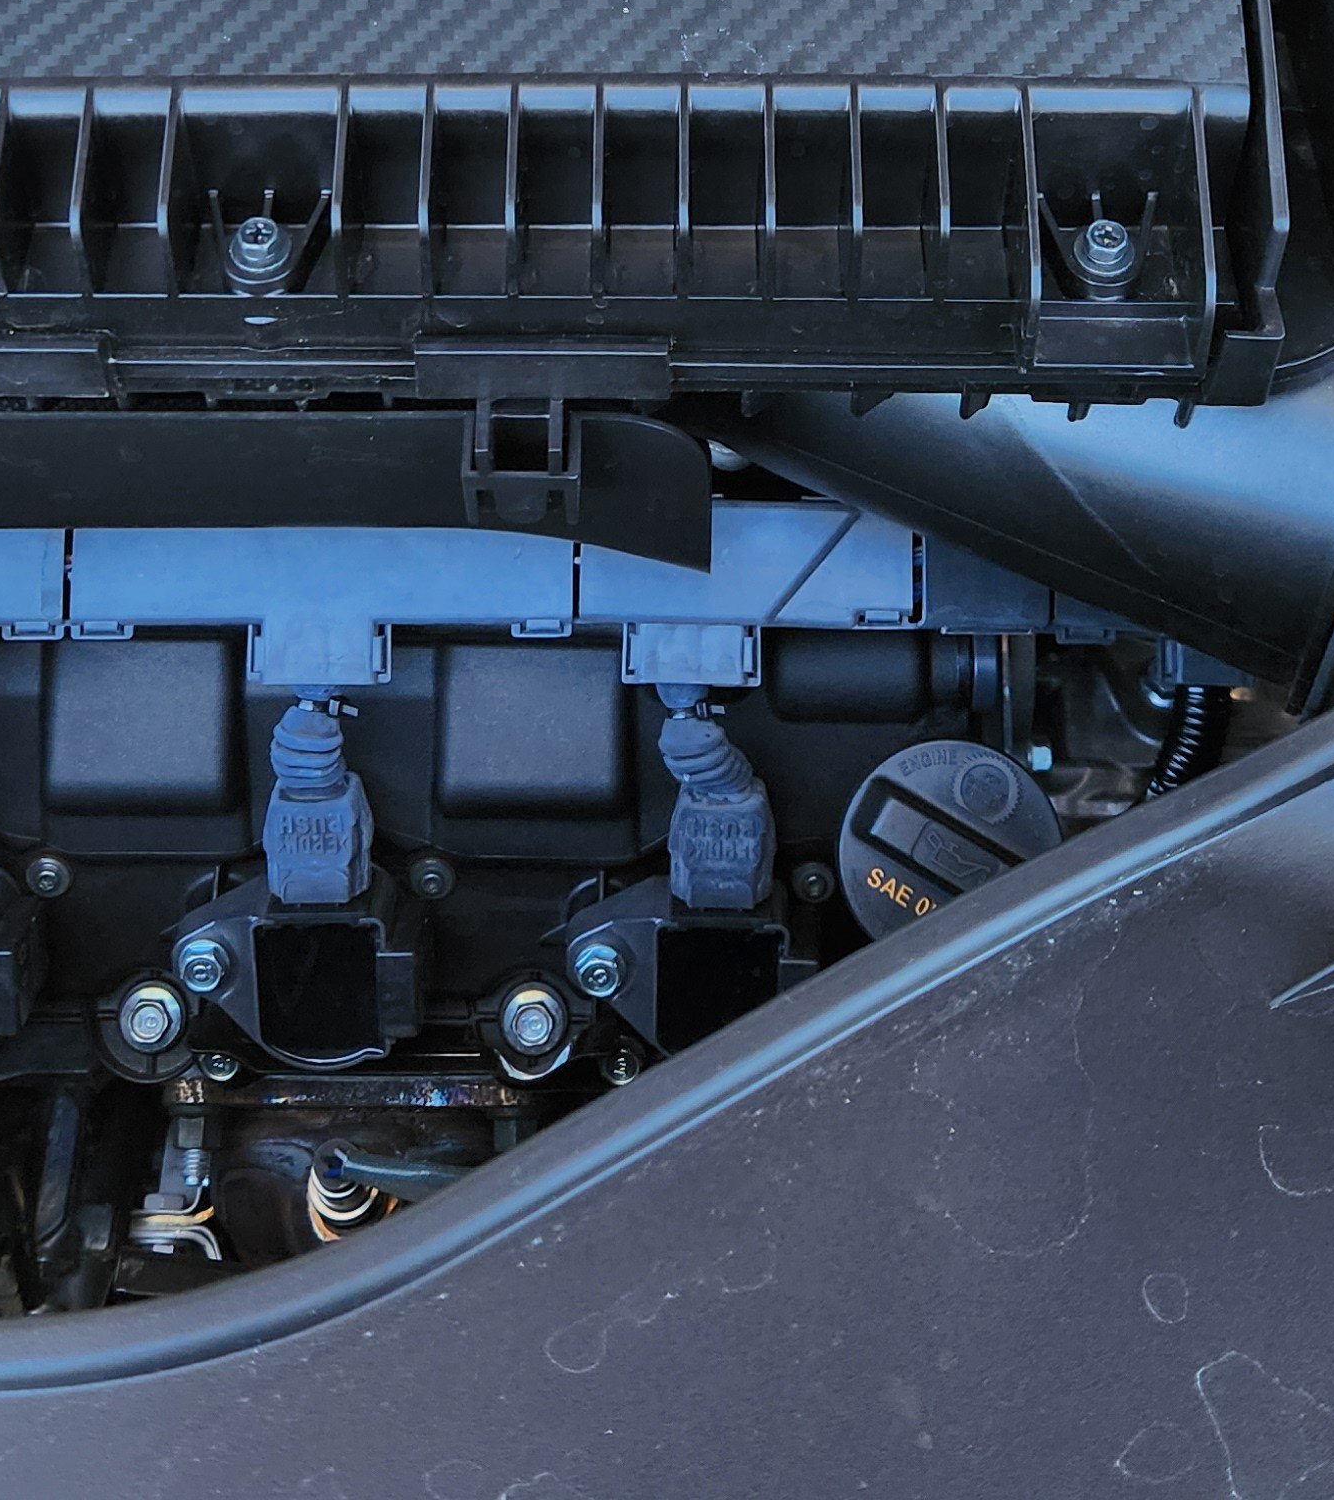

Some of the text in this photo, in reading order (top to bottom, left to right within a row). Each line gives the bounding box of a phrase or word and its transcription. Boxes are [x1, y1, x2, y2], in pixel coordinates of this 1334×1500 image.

[897, 749, 958, 778] ENGINE
[280, 814, 345, 834] PUSH
[867, 867, 938, 916] SAE 0
